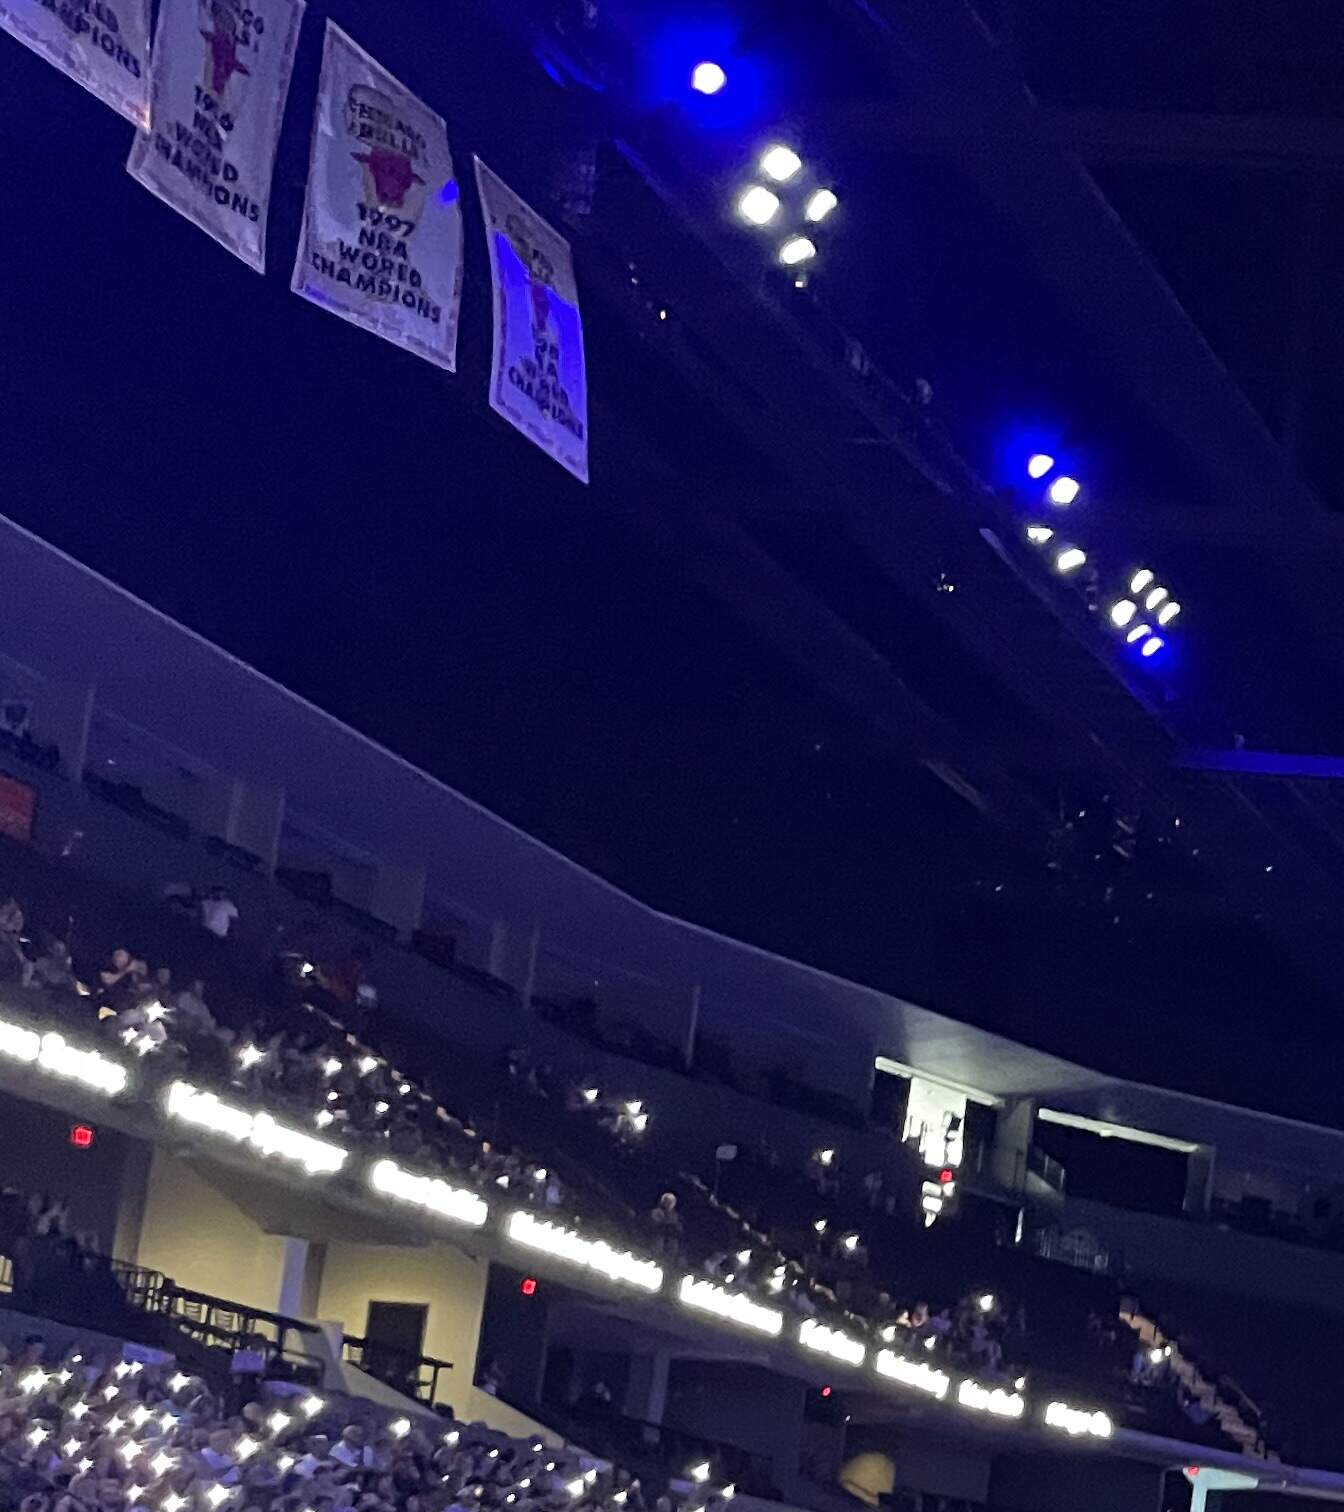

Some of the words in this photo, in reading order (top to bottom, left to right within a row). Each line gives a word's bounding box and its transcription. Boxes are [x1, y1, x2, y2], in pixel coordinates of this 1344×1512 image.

[193, 84, 234, 131] 196
[357, 202, 416, 237] 1997
[337, 236, 423, 288] WORLD
[312, 251, 443, 324] CHAMPIONS
